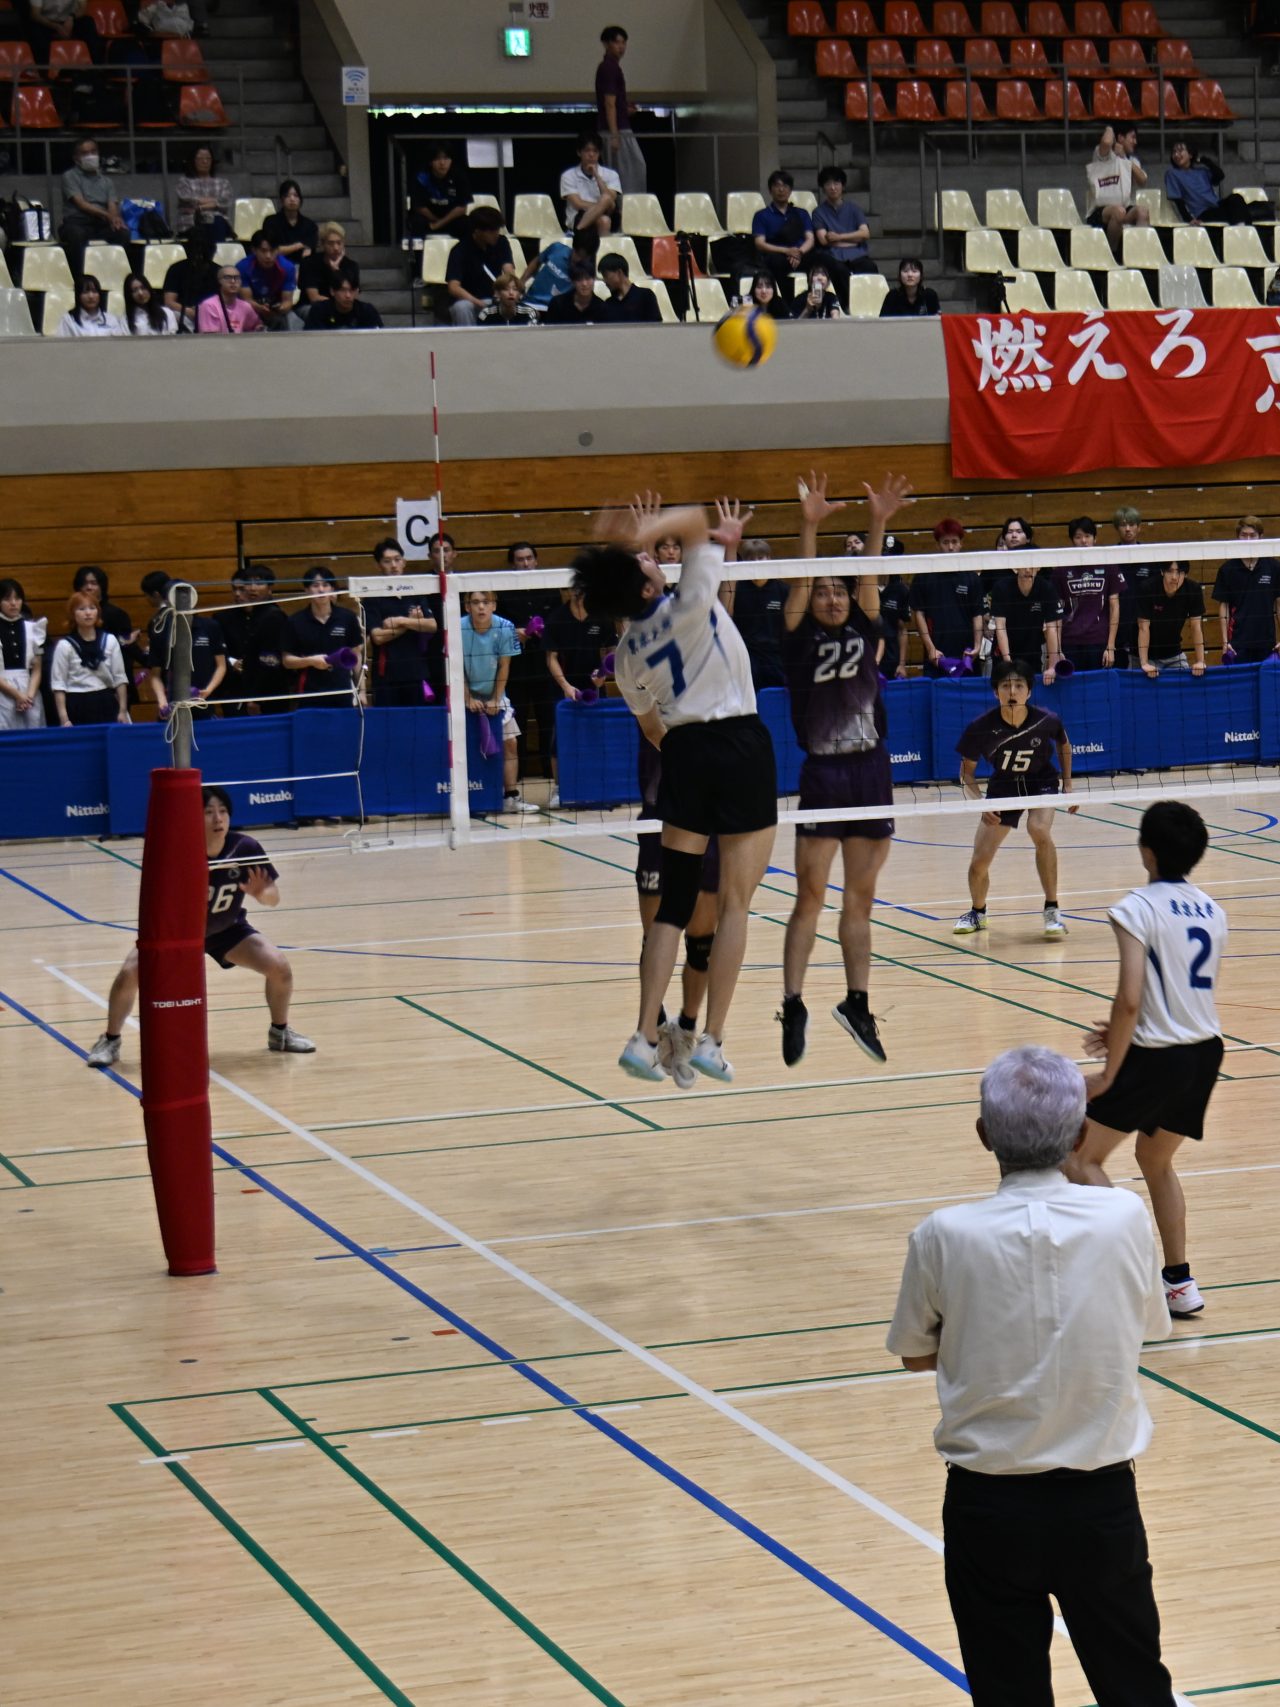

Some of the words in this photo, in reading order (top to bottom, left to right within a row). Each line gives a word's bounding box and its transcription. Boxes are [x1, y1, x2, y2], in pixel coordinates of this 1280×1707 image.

[405, 515, 430, 547] C
[645, 639, 686, 698] 7
[814, 637, 864, 683] 22
[1224, 730, 1260, 743] Nittak
[890, 750, 921, 763] ittaku
[1072, 741, 1104, 755] ittaku
[1001, 750, 1035, 772] 15
[66, 803, 109, 818] Nittak
[1187, 926, 1212, 989] 2
